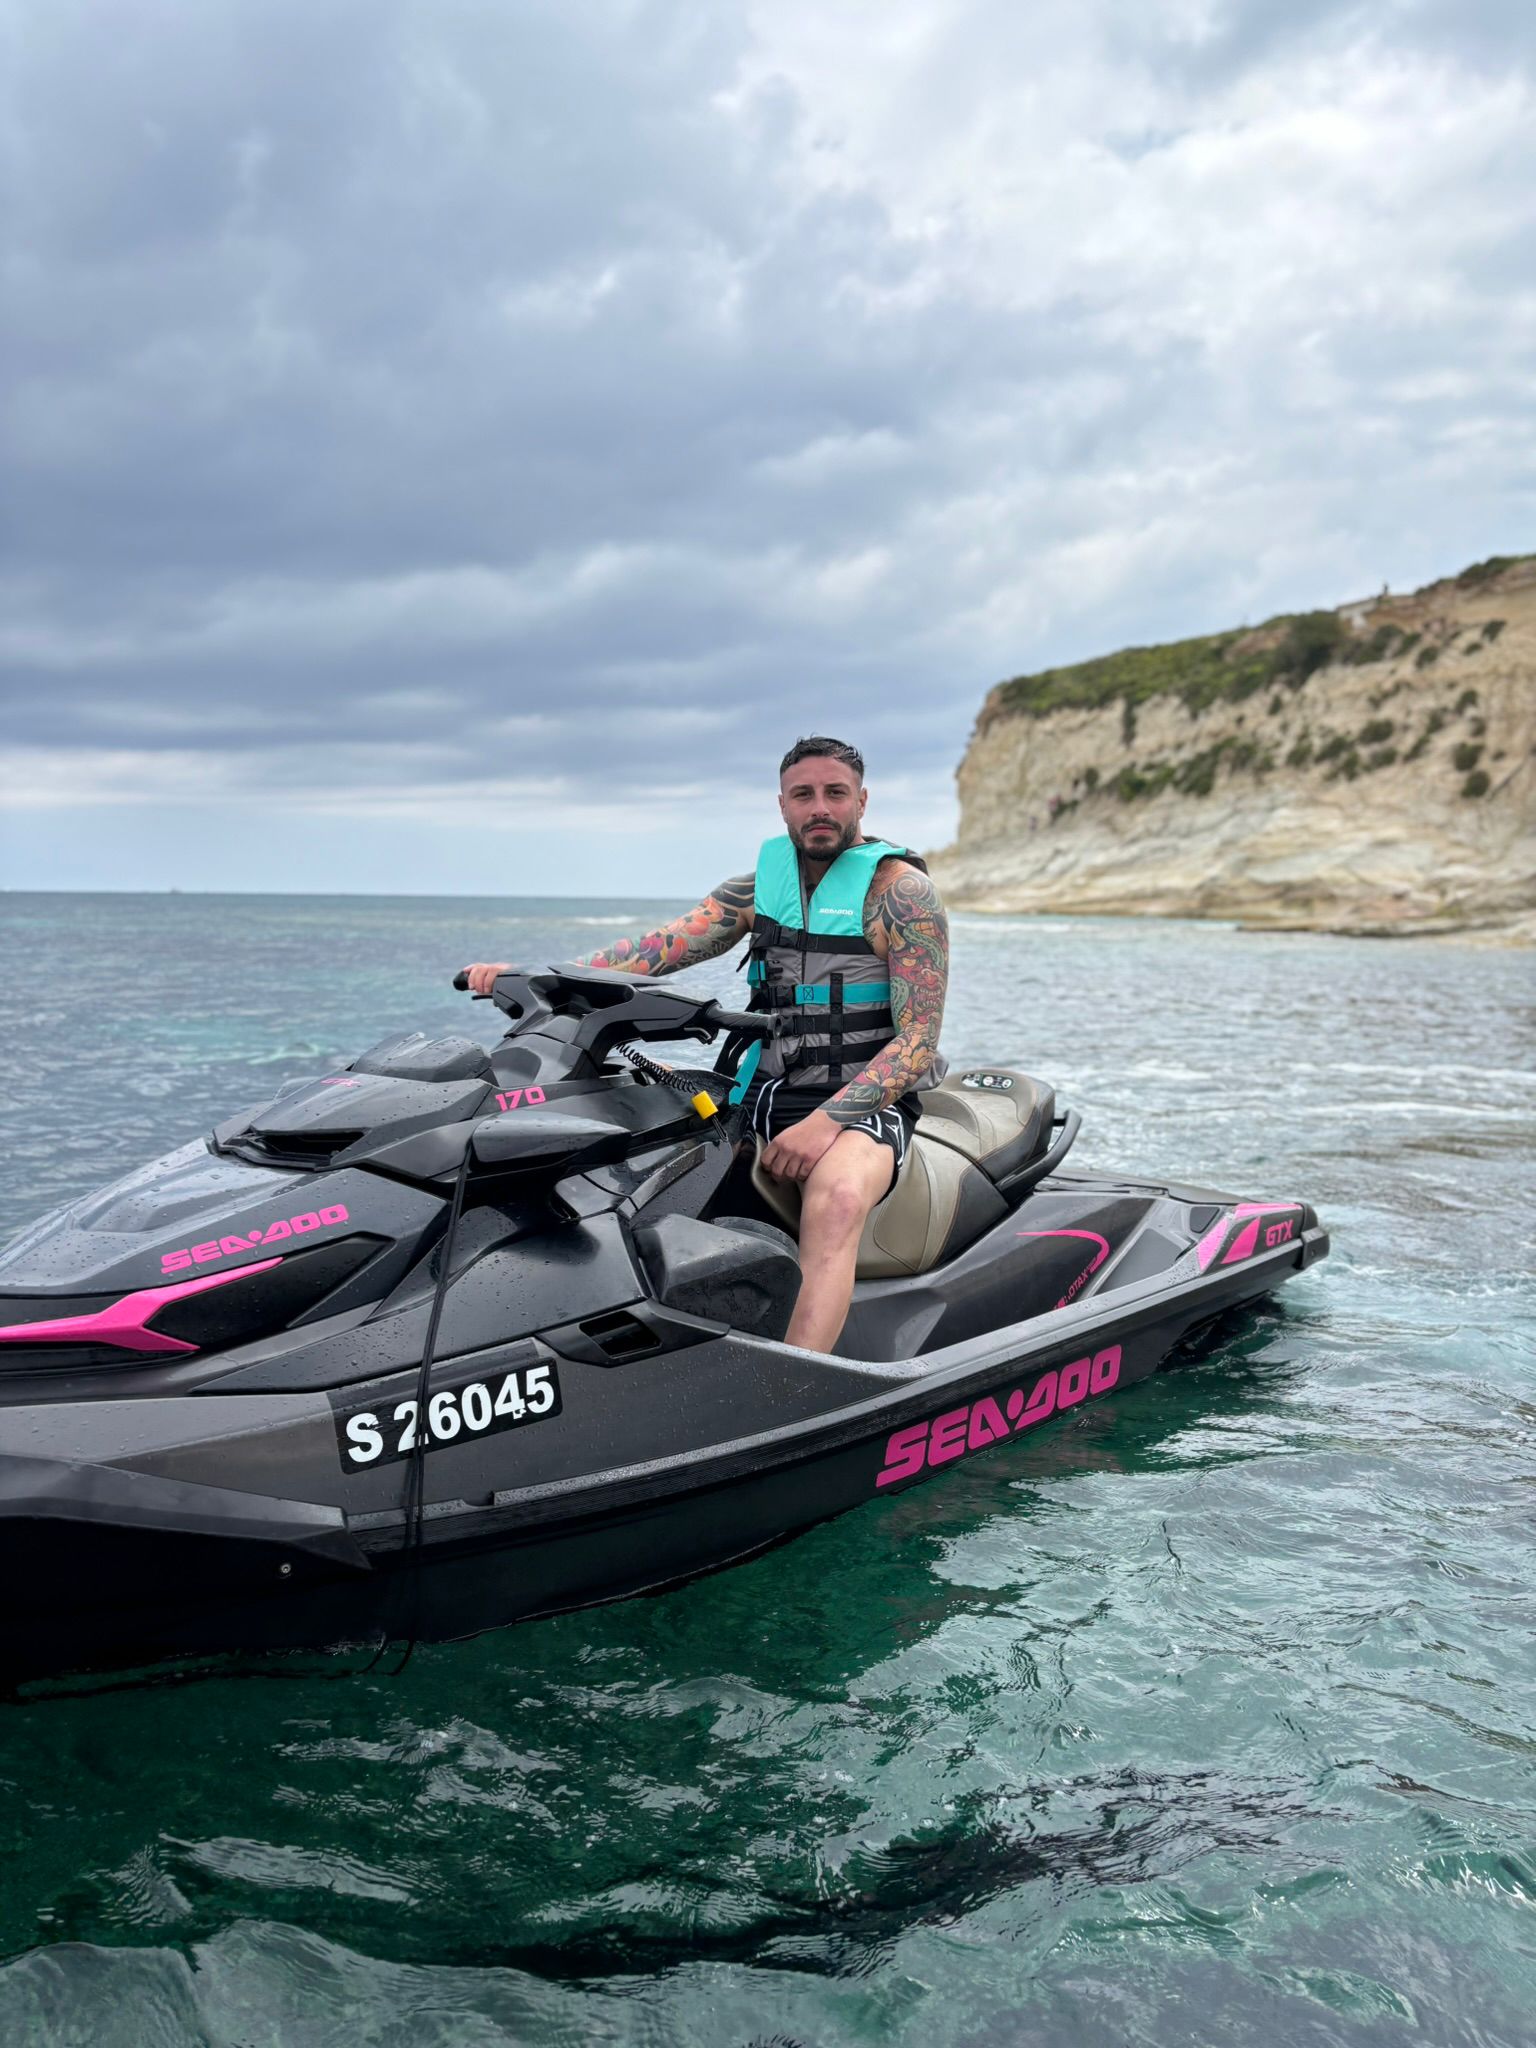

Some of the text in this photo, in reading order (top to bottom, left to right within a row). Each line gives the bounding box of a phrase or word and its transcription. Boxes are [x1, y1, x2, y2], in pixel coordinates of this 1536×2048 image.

[495, 1086, 546, 1112] 170
[1266, 1220, 1294, 1247] GTX
[346, 1365, 555, 1463] S 26045
